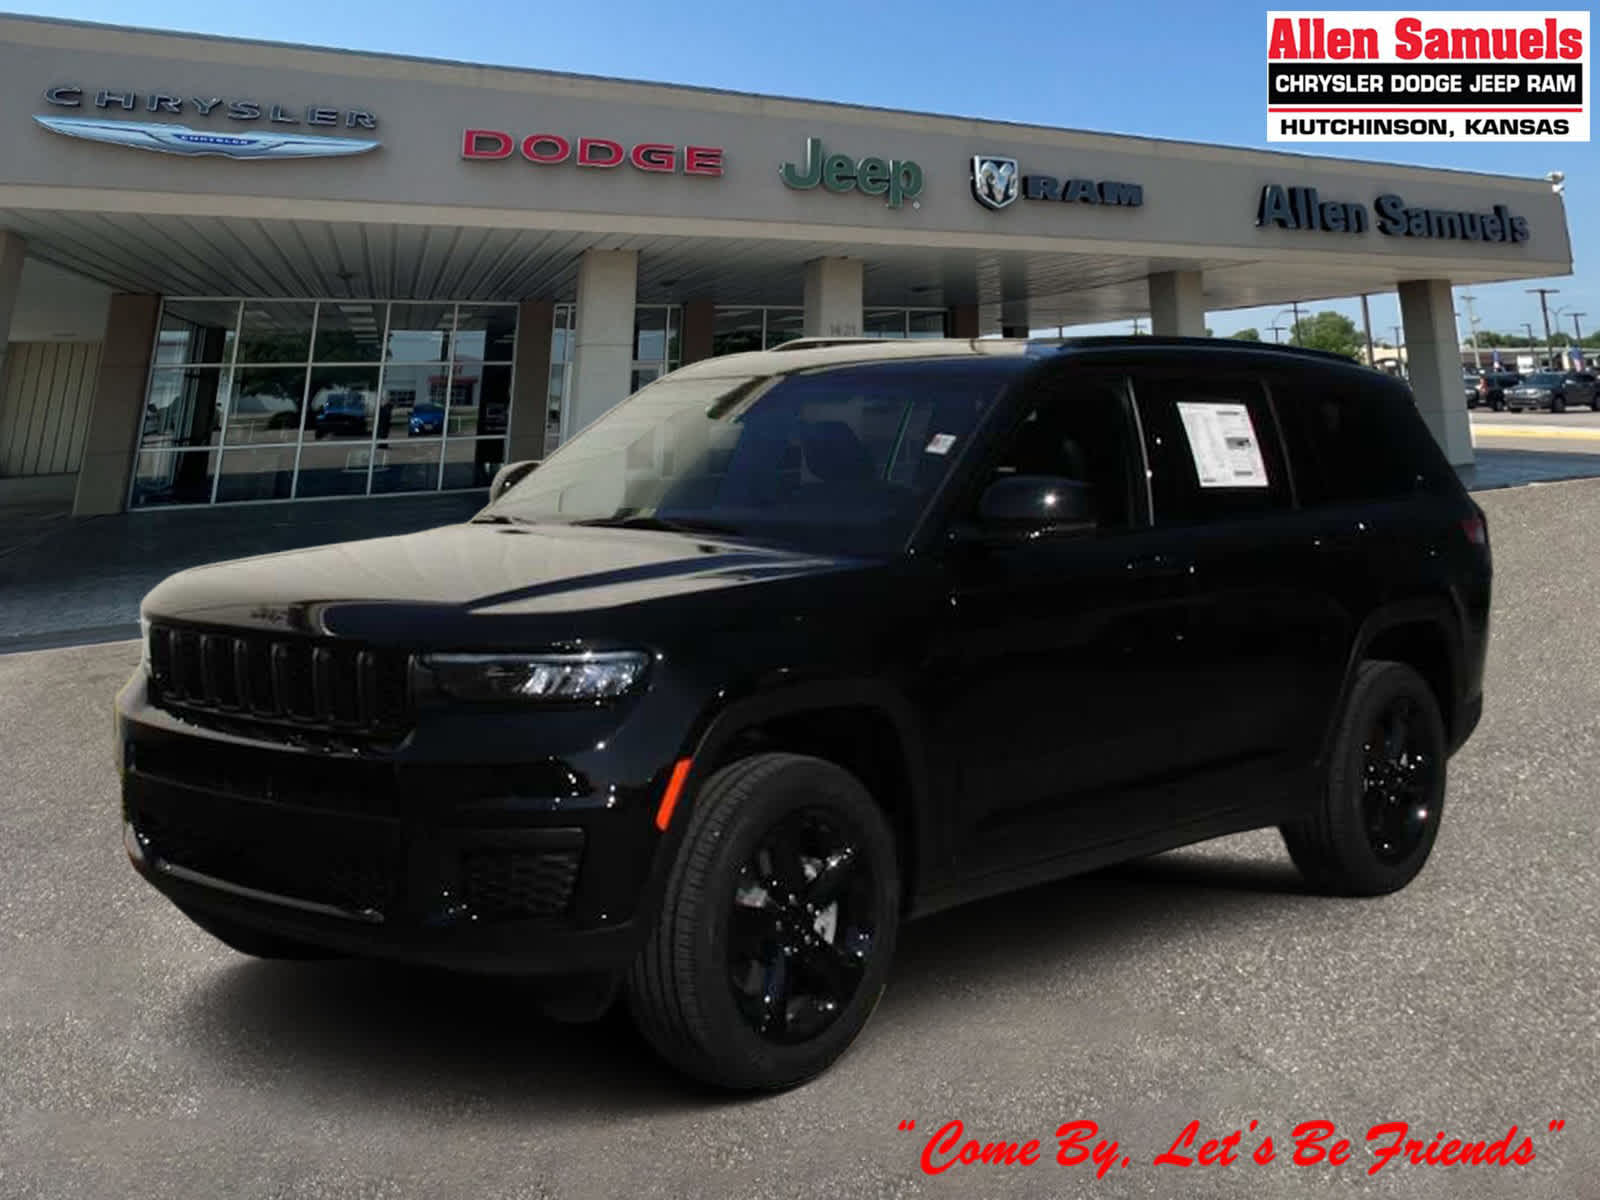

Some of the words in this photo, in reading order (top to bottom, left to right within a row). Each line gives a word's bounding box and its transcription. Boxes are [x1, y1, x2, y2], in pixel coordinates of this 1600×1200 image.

[43, 86, 379, 128] CHRYSLER
[461, 128, 724, 177] DODGE
[781, 137, 924, 209] Jeep
[1023, 174, 1144, 207] RAM
[1257, 184, 1369, 234] Allen
[1375, 194, 1531, 243] Samuels
